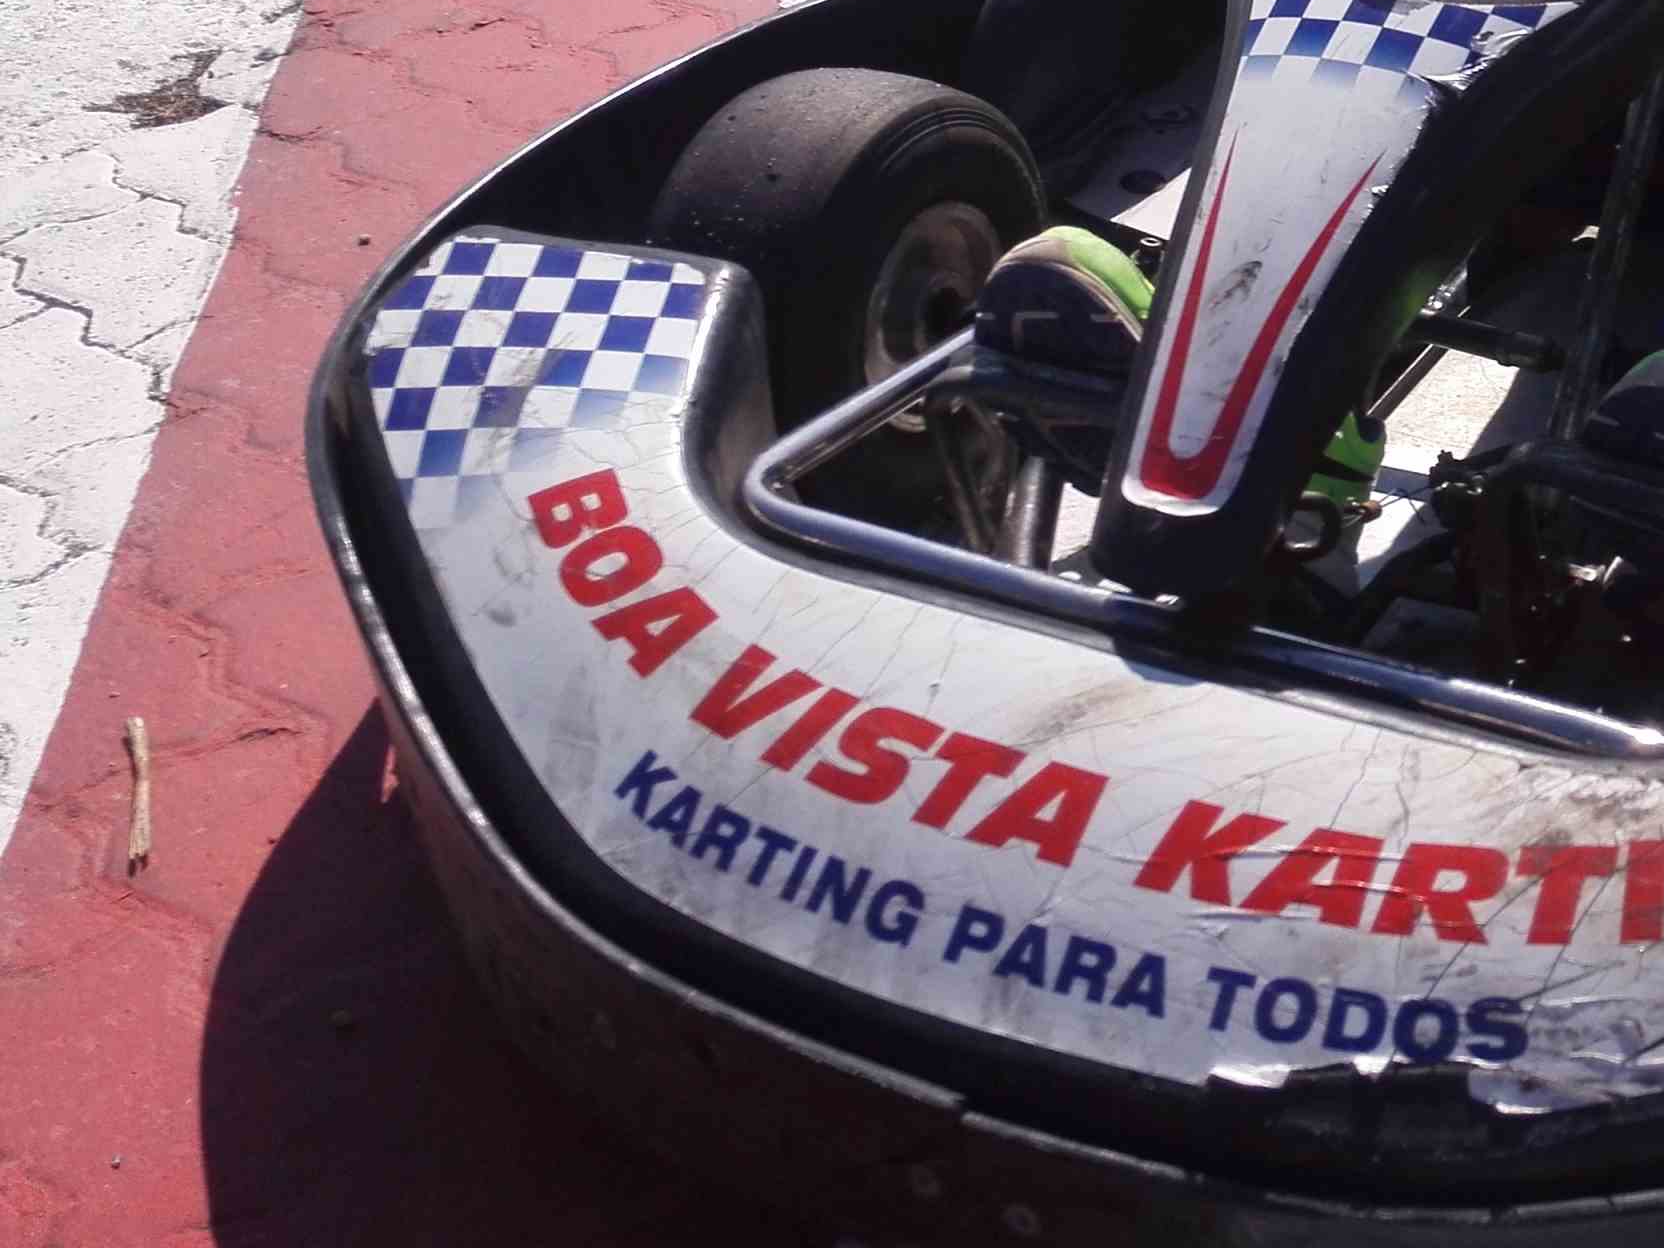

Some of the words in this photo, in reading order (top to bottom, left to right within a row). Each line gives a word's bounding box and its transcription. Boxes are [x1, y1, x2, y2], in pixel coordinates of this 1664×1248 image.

[526, 468, 719, 678] BOA
[691, 644, 1110, 868] VISTA
[613, 752, 926, 947] KARTING
[942, 906, 1167, 1018] PARA
[1206, 966, 1529, 1065] TODOS
